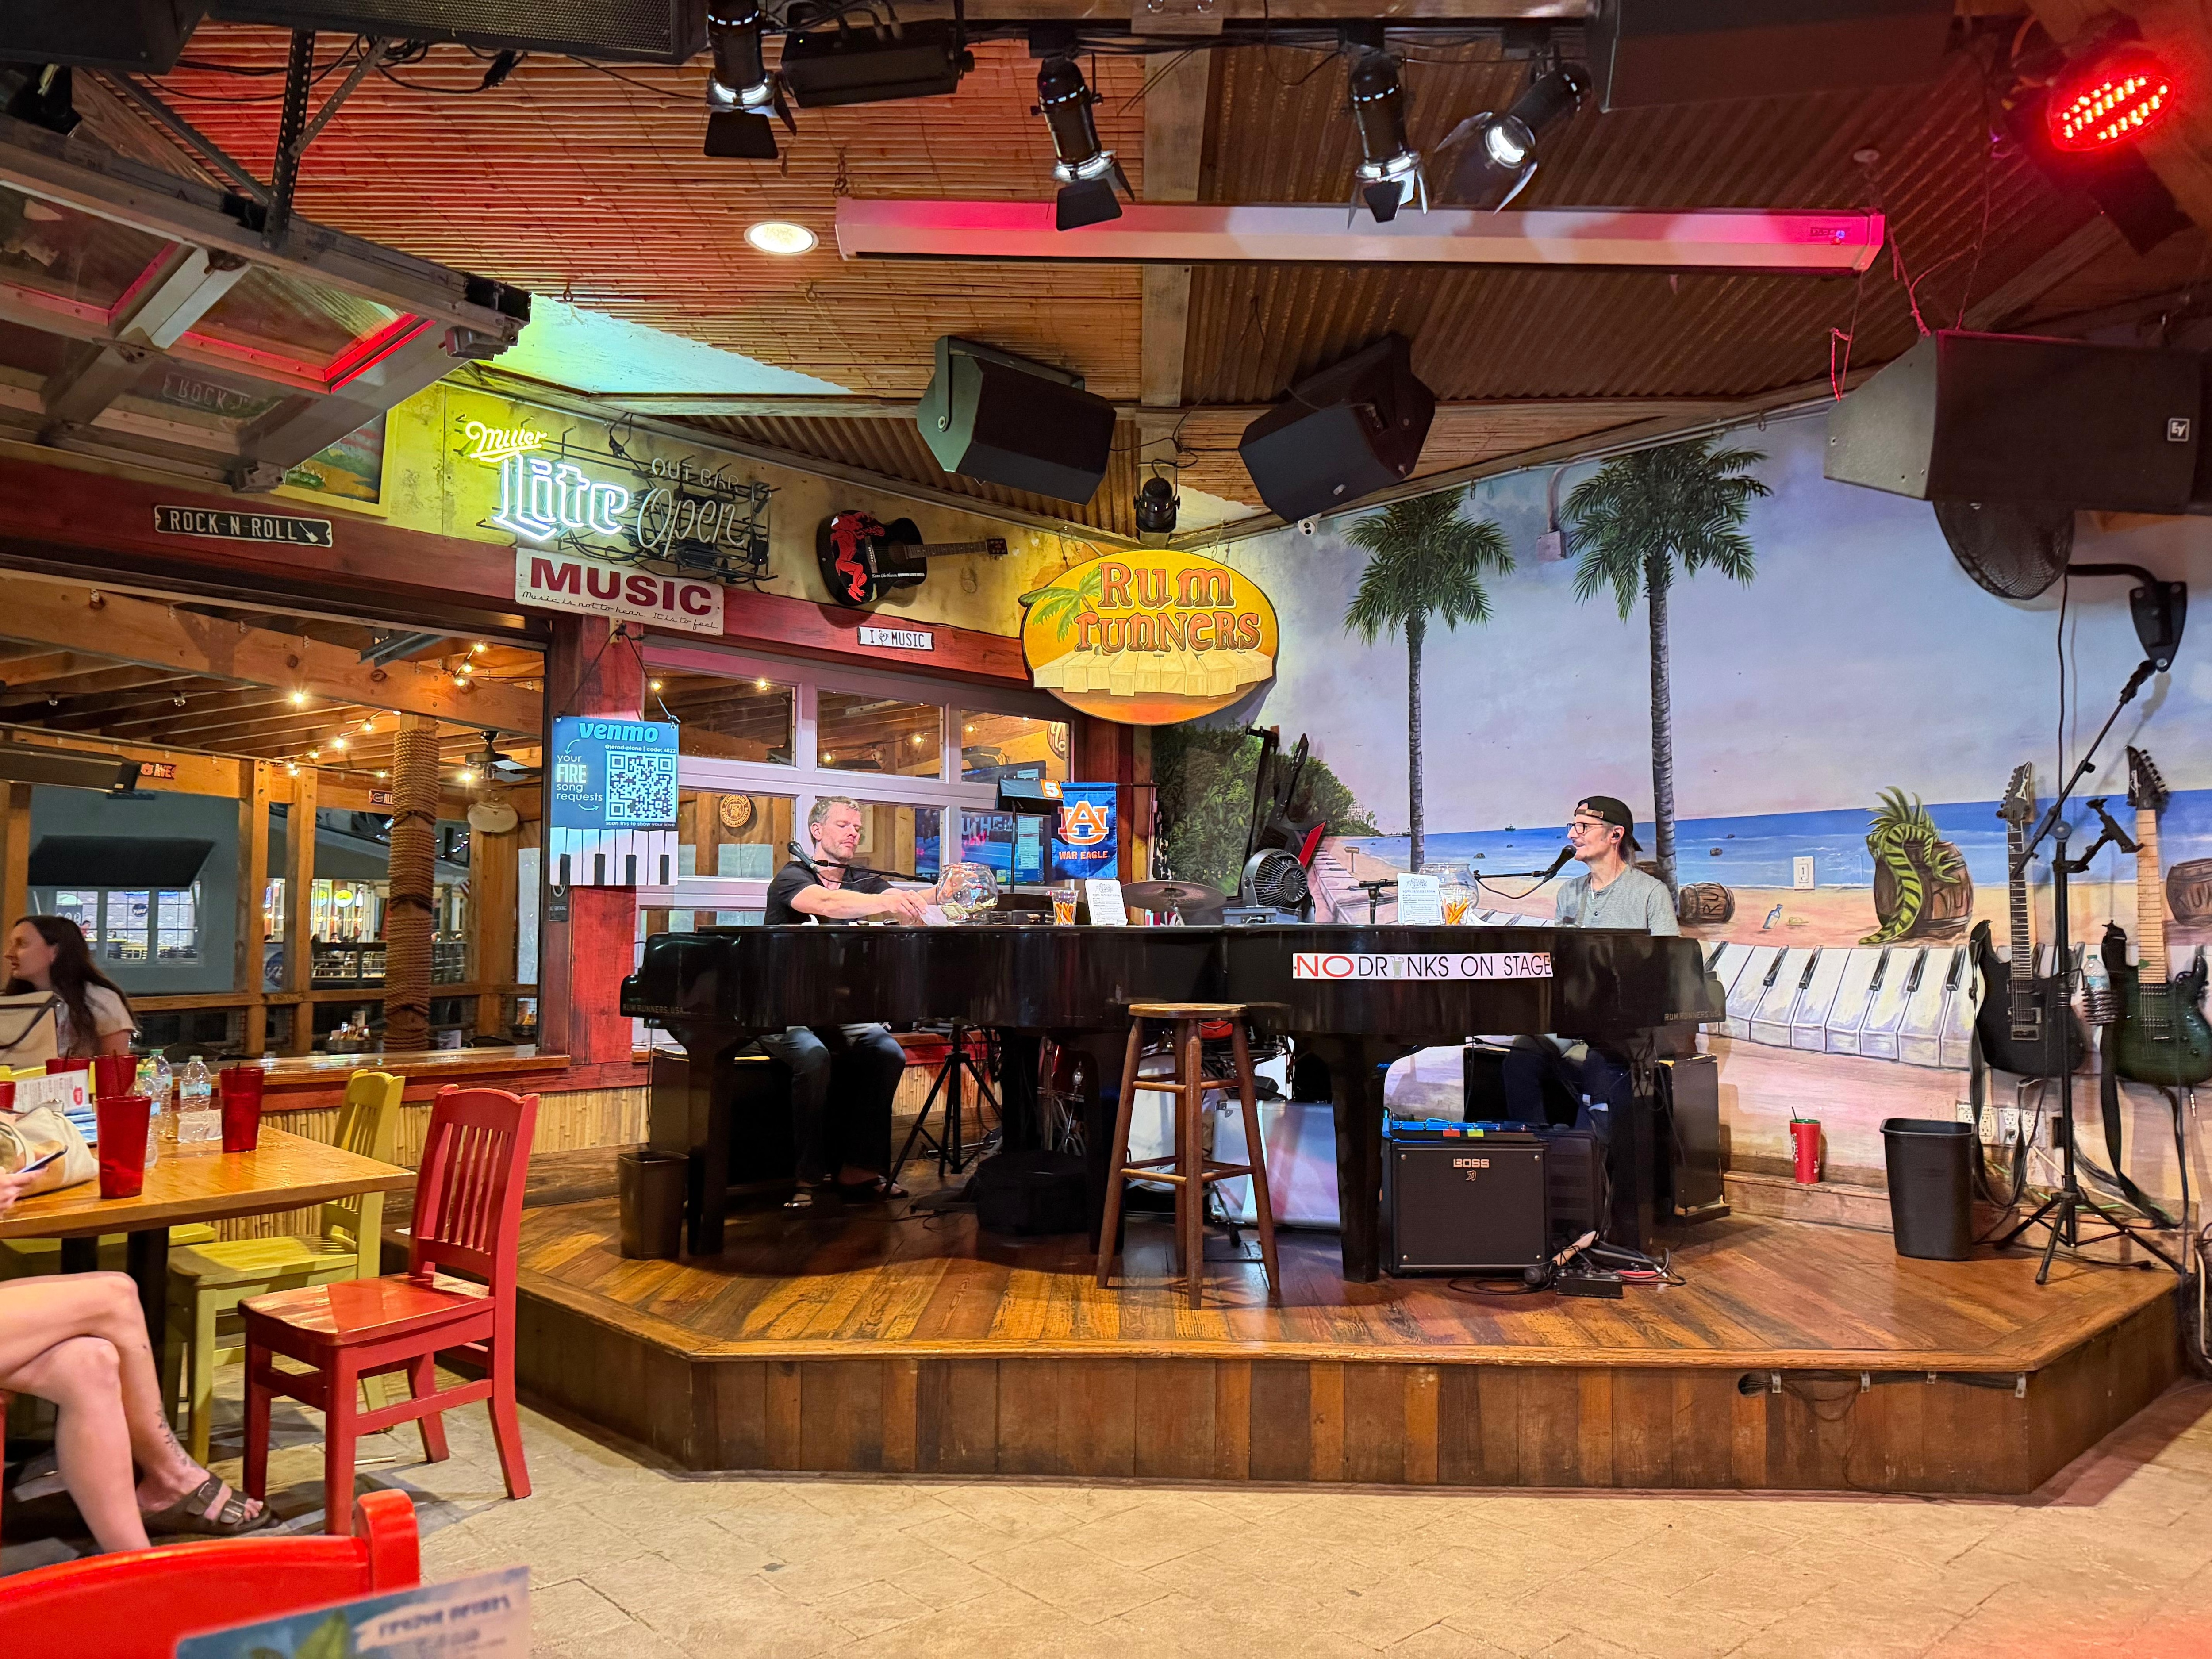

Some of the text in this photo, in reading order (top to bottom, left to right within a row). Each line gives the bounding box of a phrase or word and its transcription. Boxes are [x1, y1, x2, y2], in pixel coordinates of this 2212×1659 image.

[465, 421, 548, 458] Miller
[492, 453, 629, 541] Lite
[637, 487, 745, 557] Open
[530, 557, 712, 615] MUSIC
[1098, 562, 1236, 609] Rum
[522, 591, 559, 603] Music
[578, 600, 596, 609] not
[870, 630, 925, 647] I MUSIC
[579, 722, 659, 743] venmo
[557, 754, 582, 763] your
[557, 764, 587, 783] FIRE
[556, 792, 603, 802] requests
[557, 784, 583, 793] song
[1045, 783, 1059, 796] 5
[1297, 956, 1354, 977] NO
[1461, 956, 1493, 976] ON
[1504, 956, 1550, 976] STAGE
[1453, 1158, 1490, 1168] BOSS
